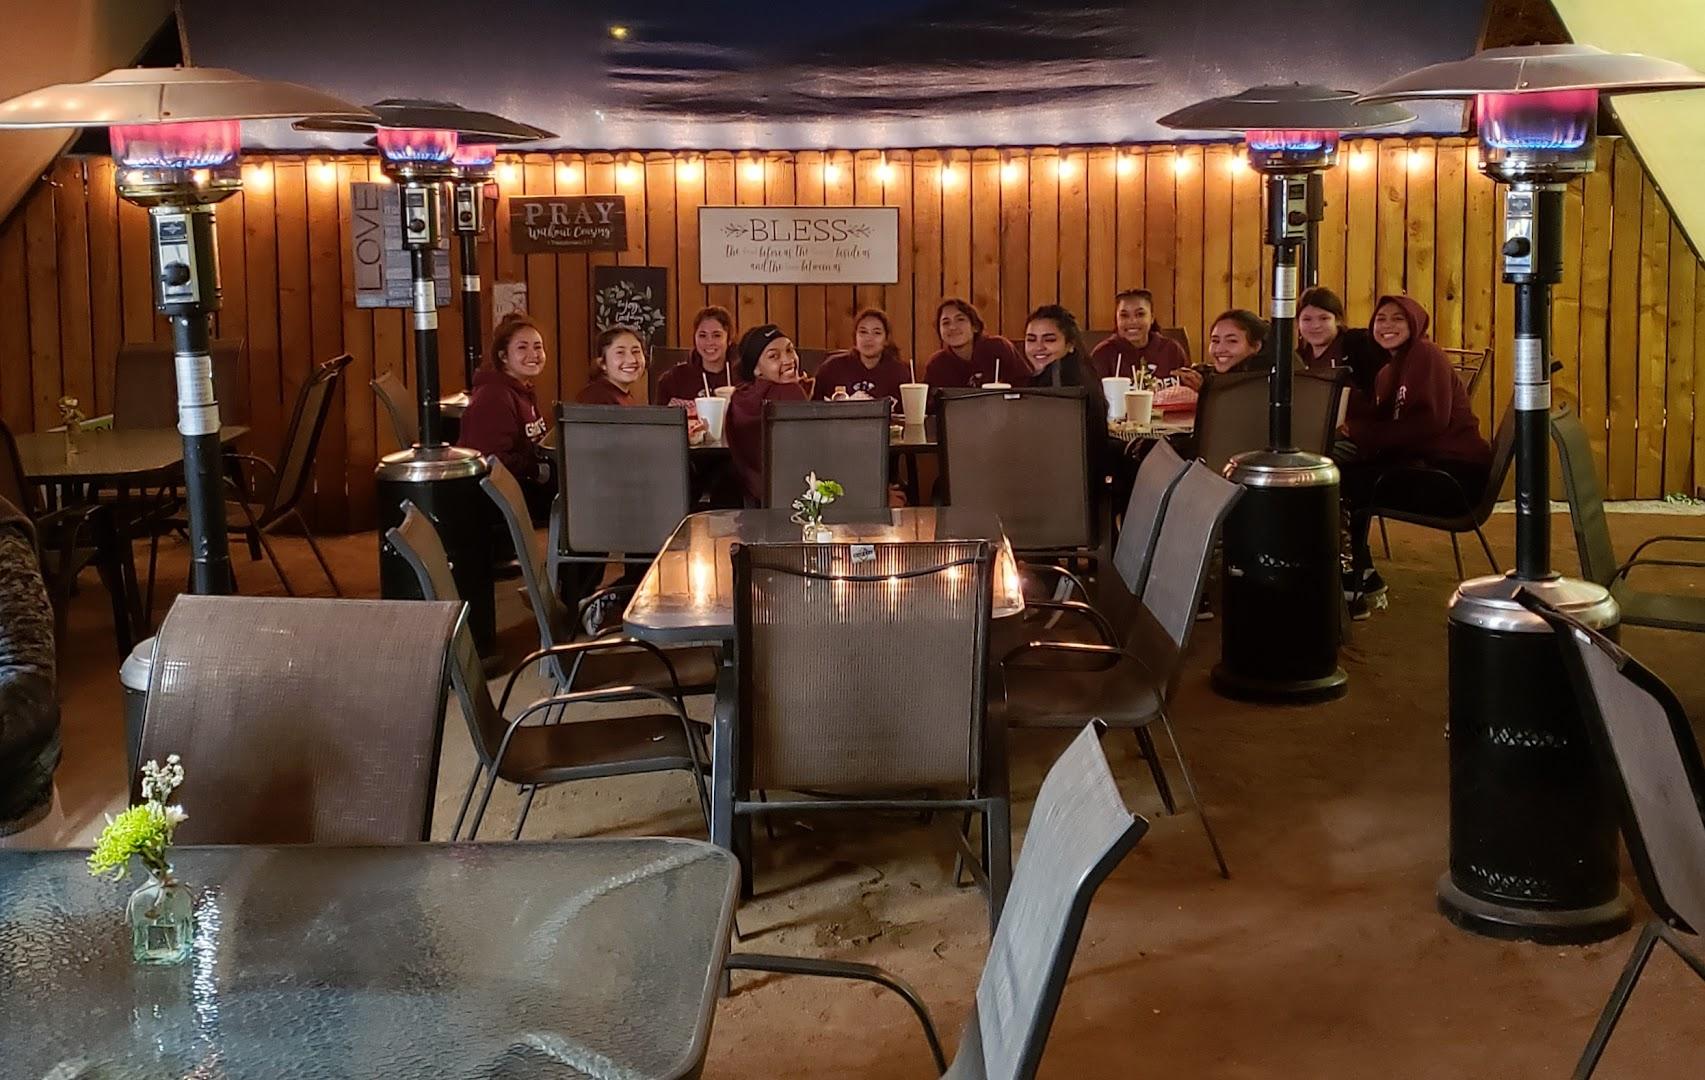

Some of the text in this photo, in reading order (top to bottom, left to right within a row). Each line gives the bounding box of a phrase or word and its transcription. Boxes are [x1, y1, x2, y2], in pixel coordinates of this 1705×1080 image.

[523, 202, 615, 226] PRAY
[353, 184, 382, 290] LOVE
[750, 218, 848, 242] BLESS
